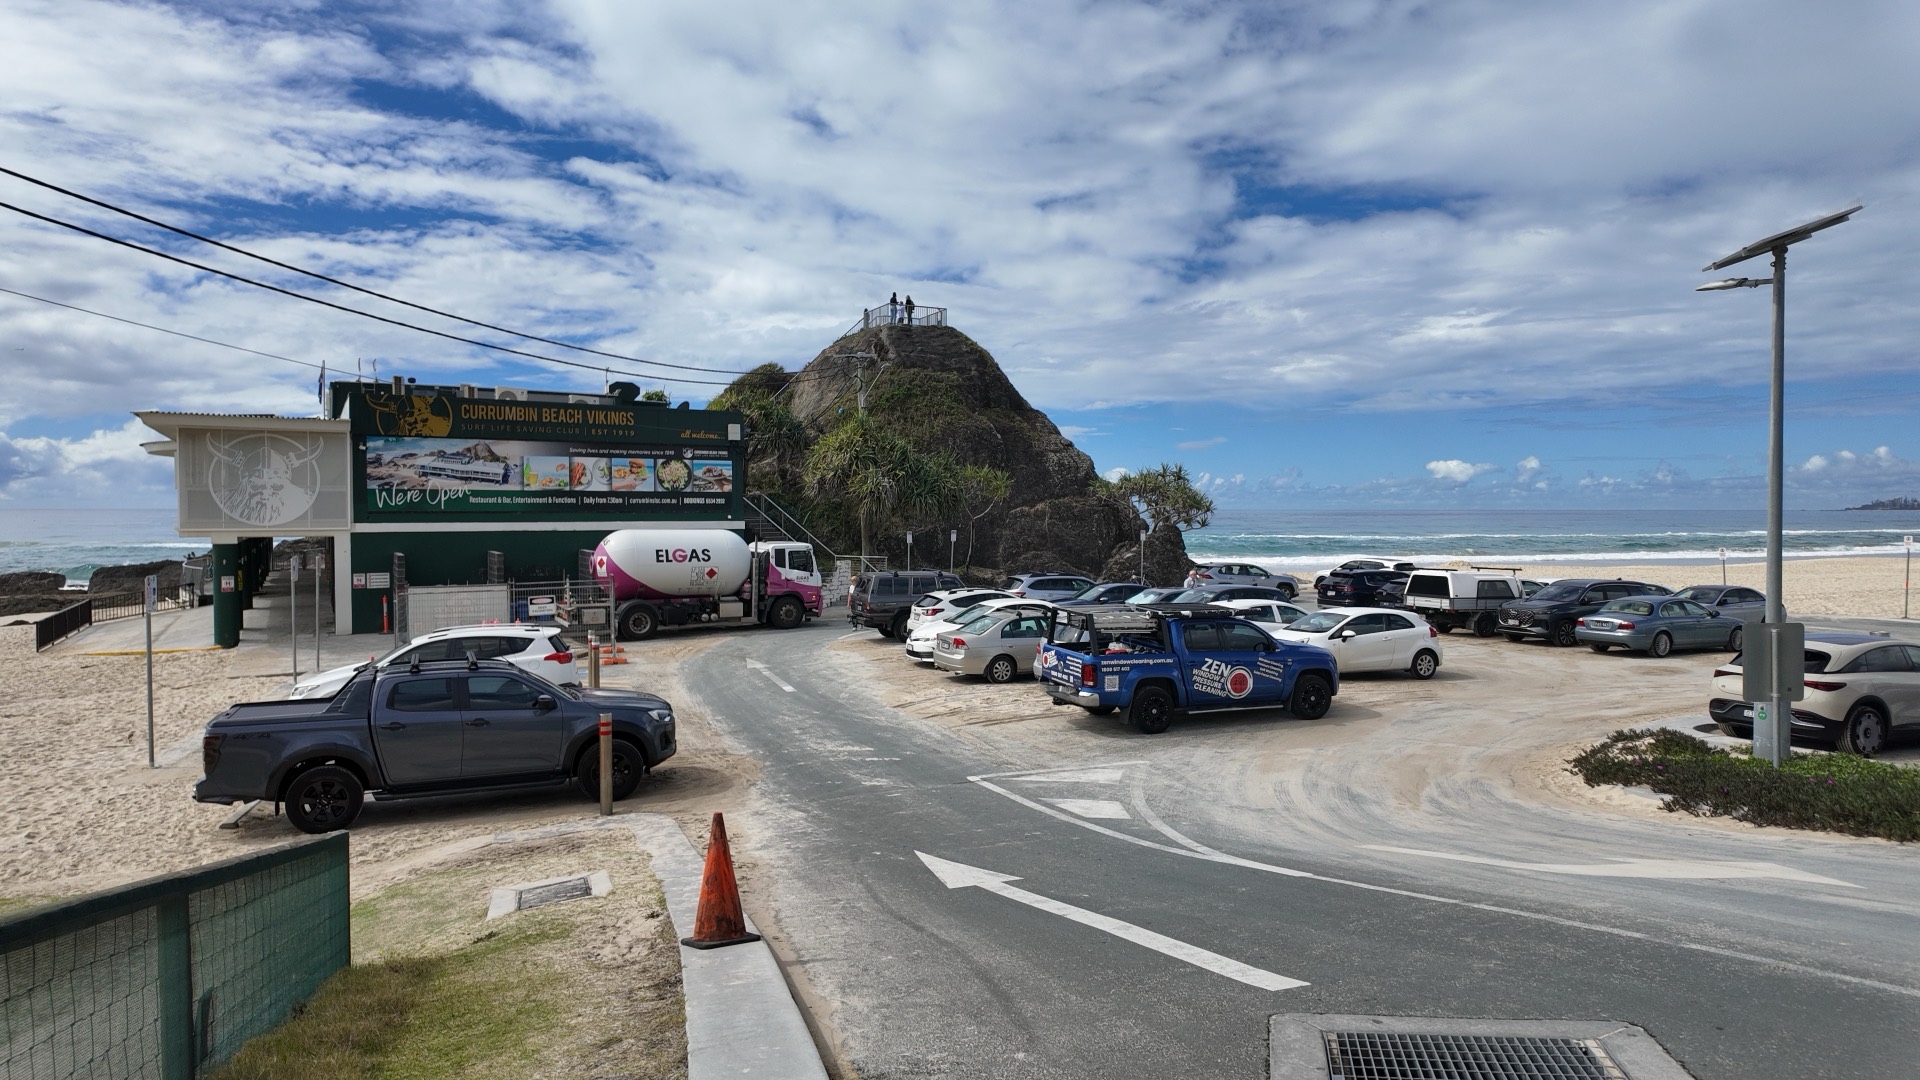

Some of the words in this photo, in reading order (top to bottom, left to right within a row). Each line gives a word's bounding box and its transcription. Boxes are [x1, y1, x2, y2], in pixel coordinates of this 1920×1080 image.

[461, 404, 538, 421] CURRUMBIN
[542, 408, 583, 424] BEACH
[587, 410, 635, 426] VIKINGS
[491, 424, 511, 432] LIFE
[516, 425, 552, 434] SAVING
[556, 427, 580, 435] CLUB
[612, 429, 635, 437] 1919
[680, 430, 691, 439] all
[375, 480, 423, 509] We're
[426, 479, 471, 509] Open
[469, 496, 497, 504] Restaurant
[497, 496, 502, 504] &
[503, 496, 512, 505] Bar,
[513, 496, 548, 504] Entertainment
[548, 496, 552, 504] &
[553, 496, 576, 504] Functions
[583, 496, 595, 505] Daily
[596, 496, 606, 504] from
[656, 549, 711, 563] ELGAS
[1192, 668, 1220, 680] WINDOW
[1201, 658, 1231, 677] ZEN
[1192, 676, 1222, 688] PRESSURE
[1194, 684, 1227, 698] CLEANING
